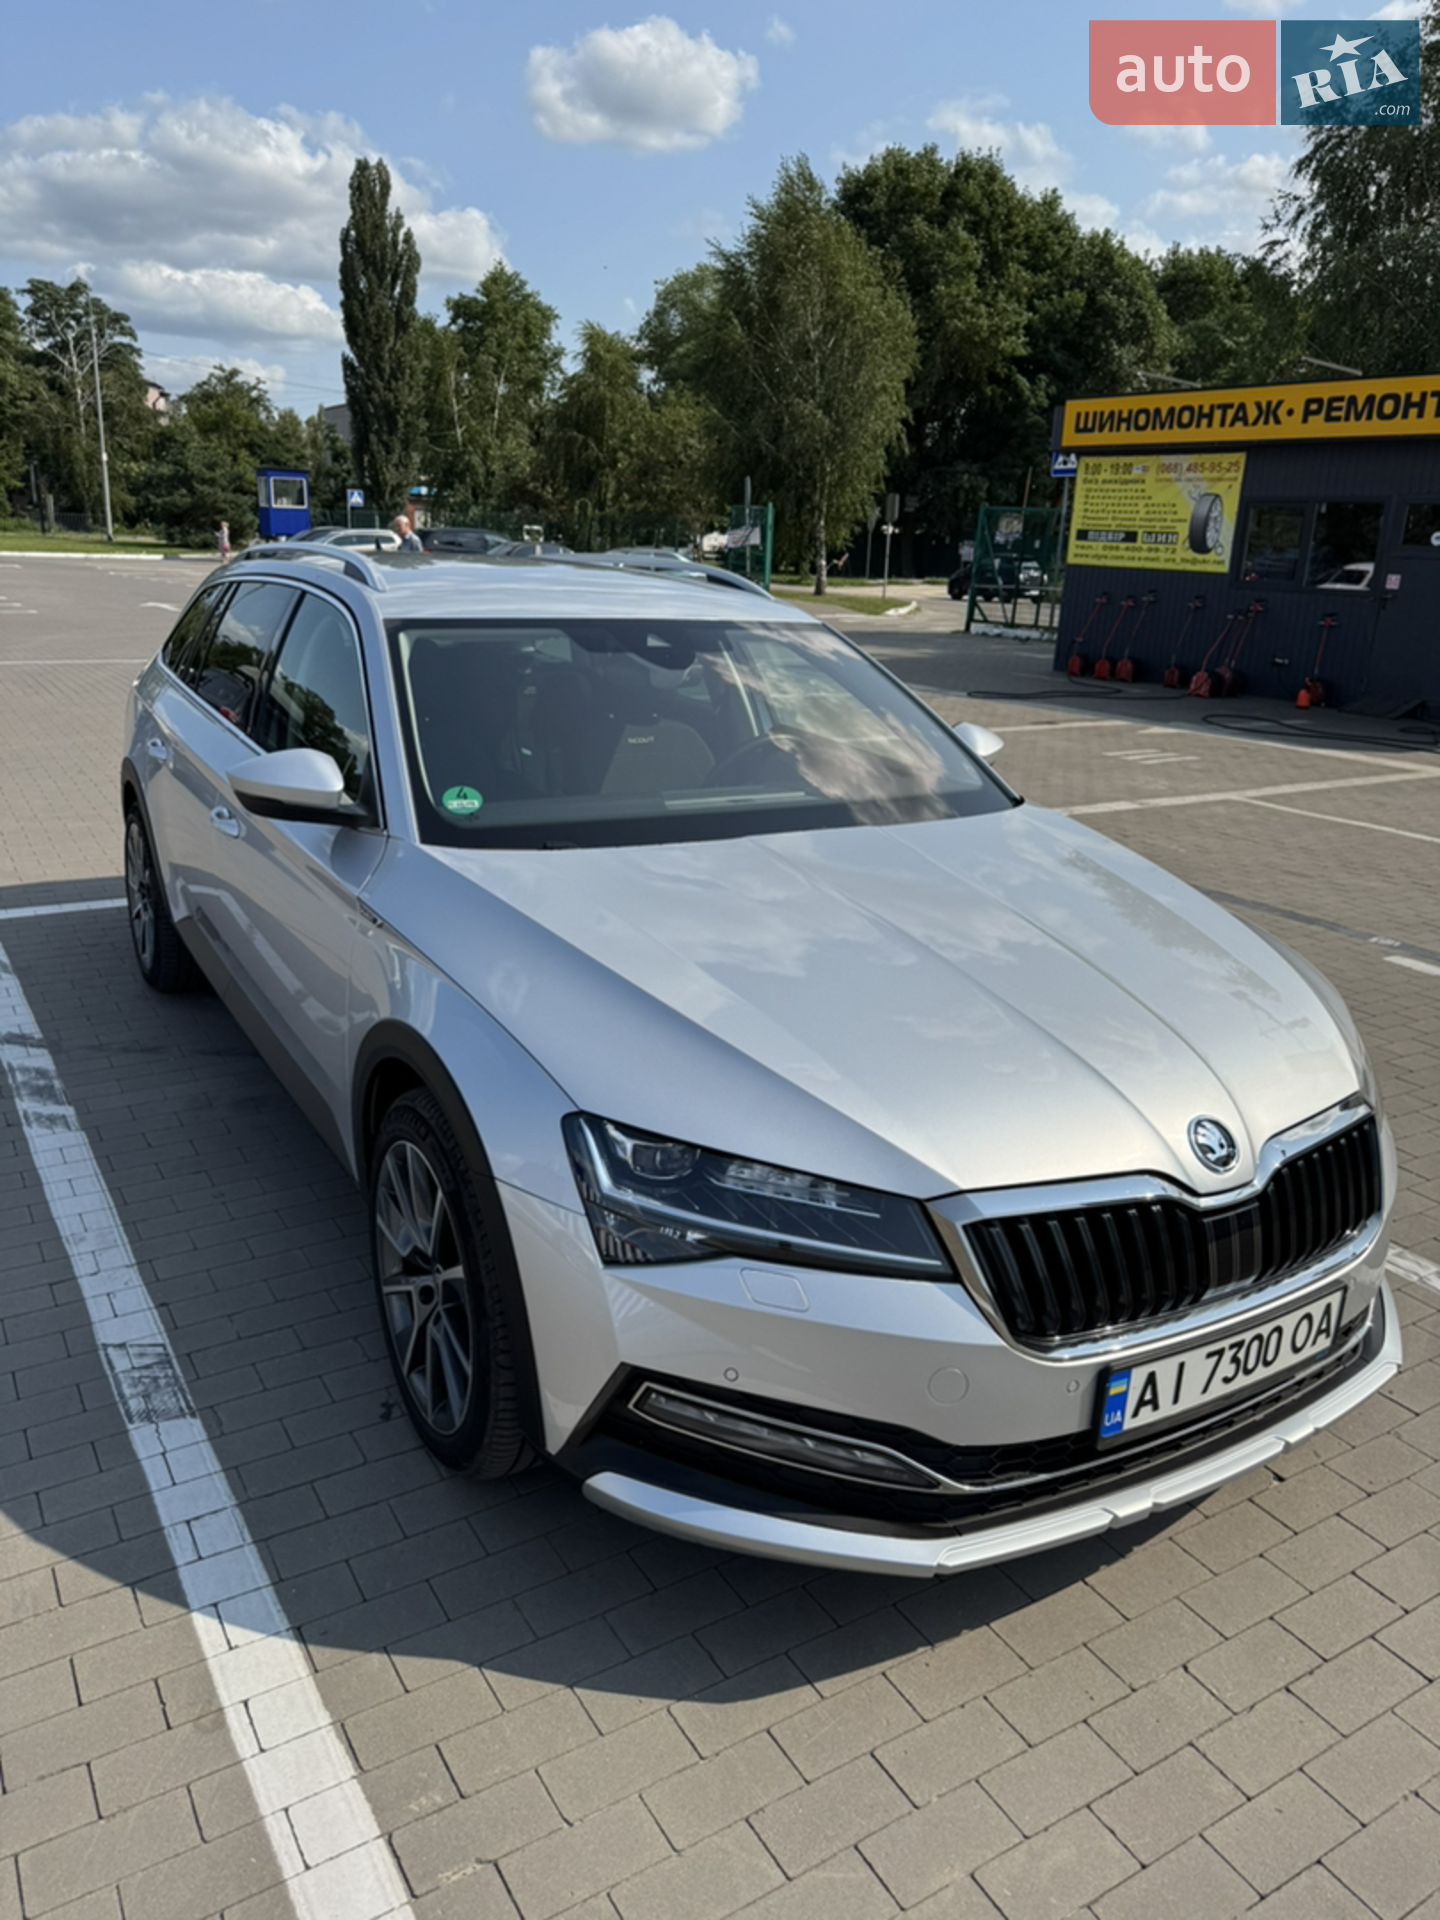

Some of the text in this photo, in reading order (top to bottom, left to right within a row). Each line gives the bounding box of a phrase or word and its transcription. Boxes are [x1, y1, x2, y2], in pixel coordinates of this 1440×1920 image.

[1074, 399, 1284, 434] ШИНОМОНТАЖ
[1201, 1325, 1284, 1395] 7300
[1291, 1302, 1333, 1354] OA
[1104, 1411, 1123, 1427] UA
